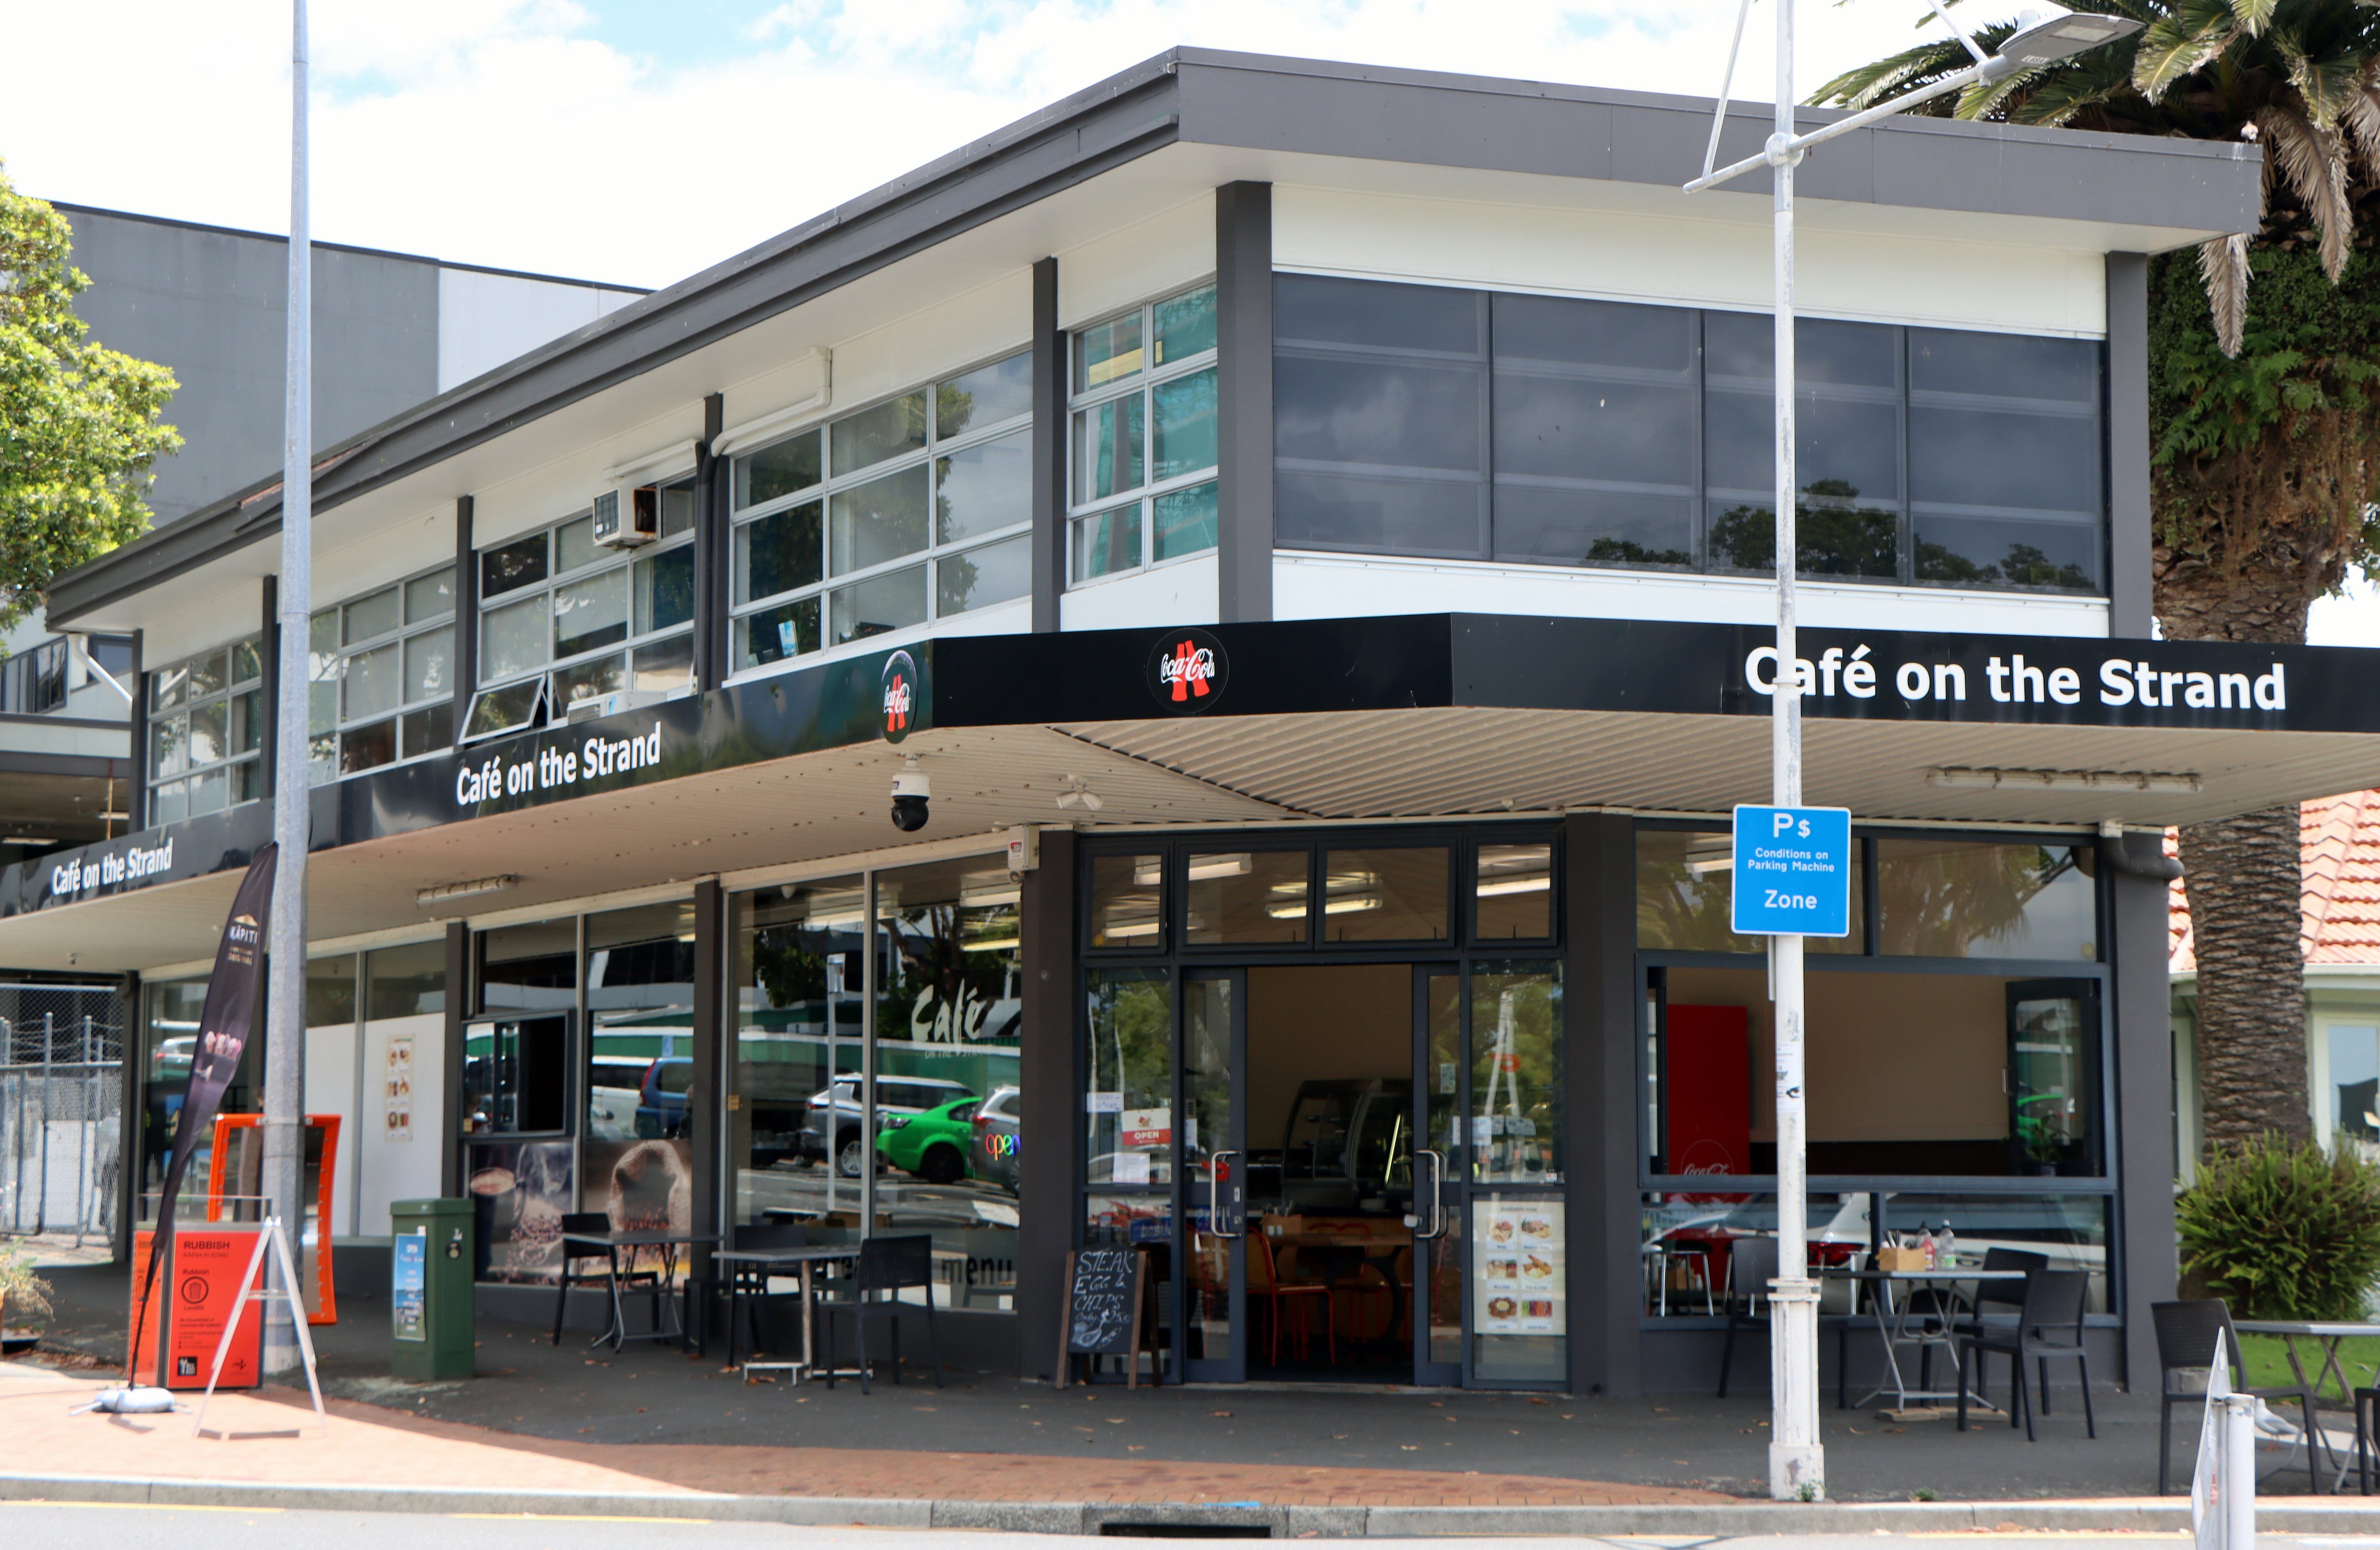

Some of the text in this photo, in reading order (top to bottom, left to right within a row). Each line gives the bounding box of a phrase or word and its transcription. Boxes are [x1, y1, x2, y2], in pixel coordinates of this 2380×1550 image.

[1161, 648, 1215, 683] Coca-Cola
[1745, 644, 2286, 710] Café on the Strand
[457, 721, 662, 805] Café on the Strand
[1755, 848, 1811, 859] Conditions
[51, 837, 173, 895] Café on the Strand
[1748, 859, 1835, 872] Parking Machine
[1765, 889, 1817, 909] Zone
[911, 978, 981, 1056] Café
[1134, 1130, 1159, 1140] OPEN
[184, 1241, 230, 1249] RUBBISH
[942, 1257, 1012, 1285] menu
[1077, 1250, 1134, 1274] STEAK
[1074, 1275, 1111, 1294] EGG
[1075, 1293, 1125, 1311] CHIPS
